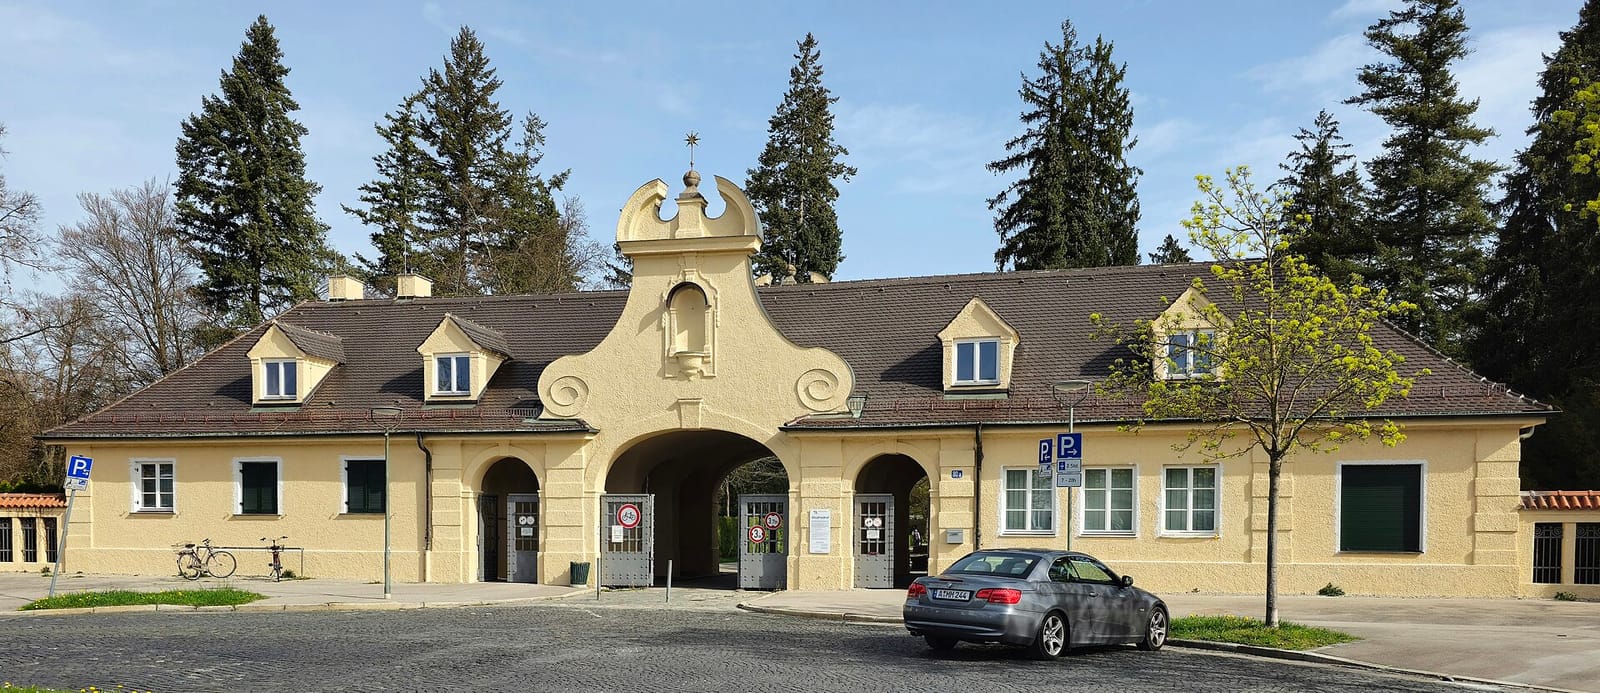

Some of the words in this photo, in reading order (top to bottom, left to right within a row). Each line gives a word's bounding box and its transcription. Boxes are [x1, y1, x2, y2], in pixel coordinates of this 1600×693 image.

[1040, 442, 1049, 461] P
[1061, 436, 1075, 456] P
[72, 459, 87, 475] P
